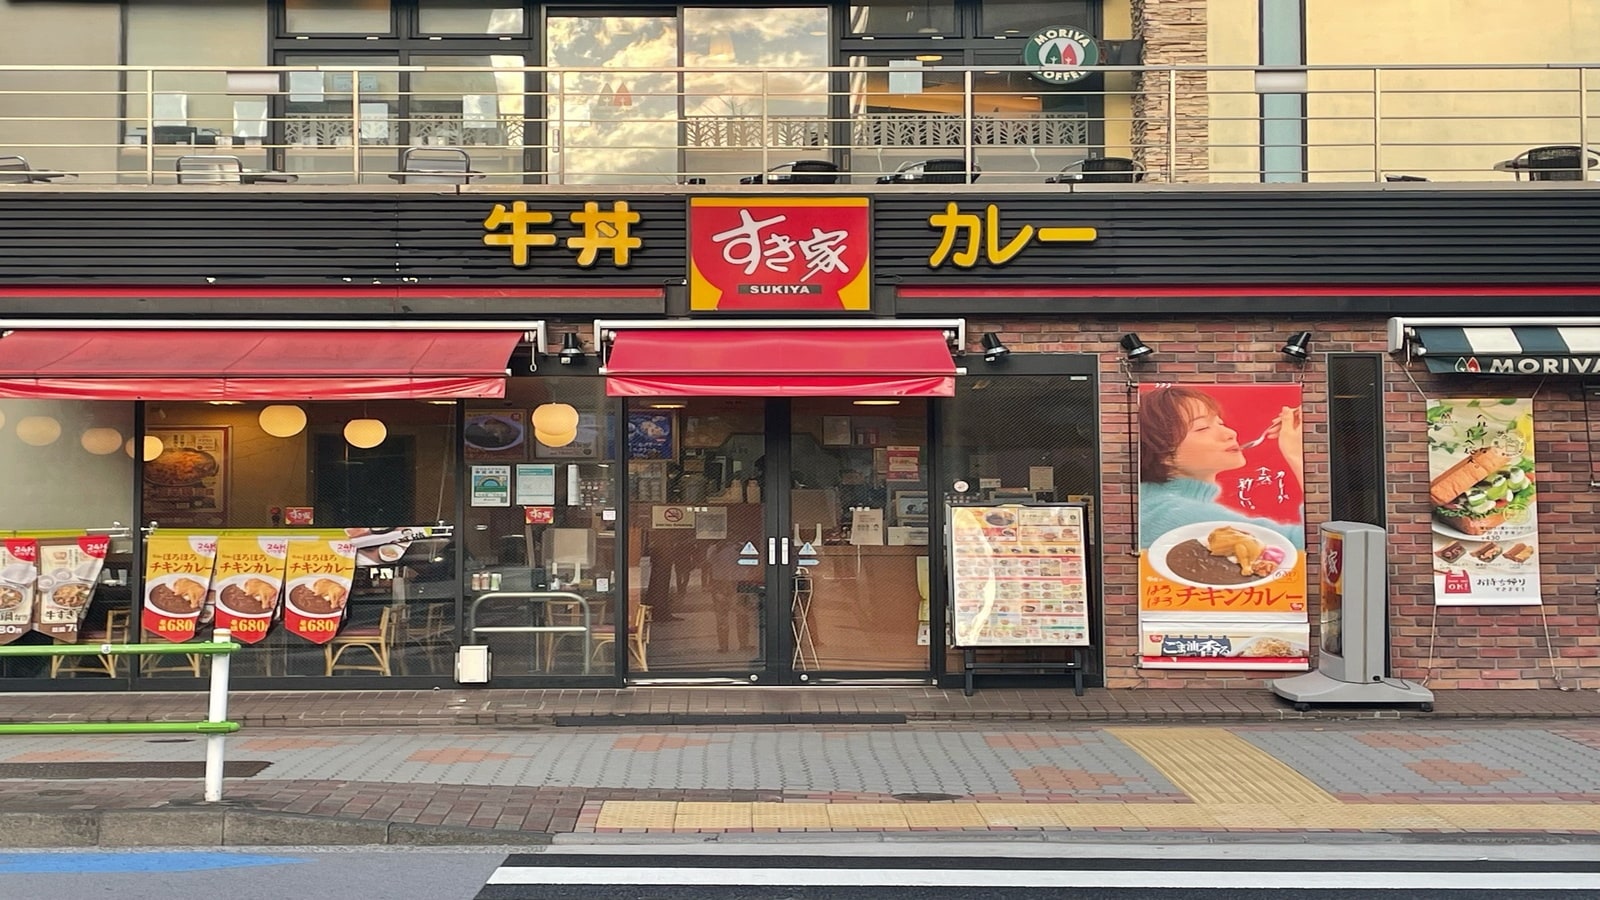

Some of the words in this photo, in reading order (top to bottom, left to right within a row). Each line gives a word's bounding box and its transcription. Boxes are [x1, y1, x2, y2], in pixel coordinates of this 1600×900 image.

[1034, 28, 1091, 48] MORIVA
[1036, 70, 1088, 81] OFFE
[482, 200, 642, 268] 牛丼
[928, 201, 1098, 269] カレー
[712, 208, 849, 281] すき家
[749, 284, 811, 295] SUKIYA
[150, 561, 212, 574] チキンカレー
[220, 562, 285, 574] チキンカレー
[289, 561, 354, 574] チキンカレー
[1176, 586, 1304, 607] チキンカレー
